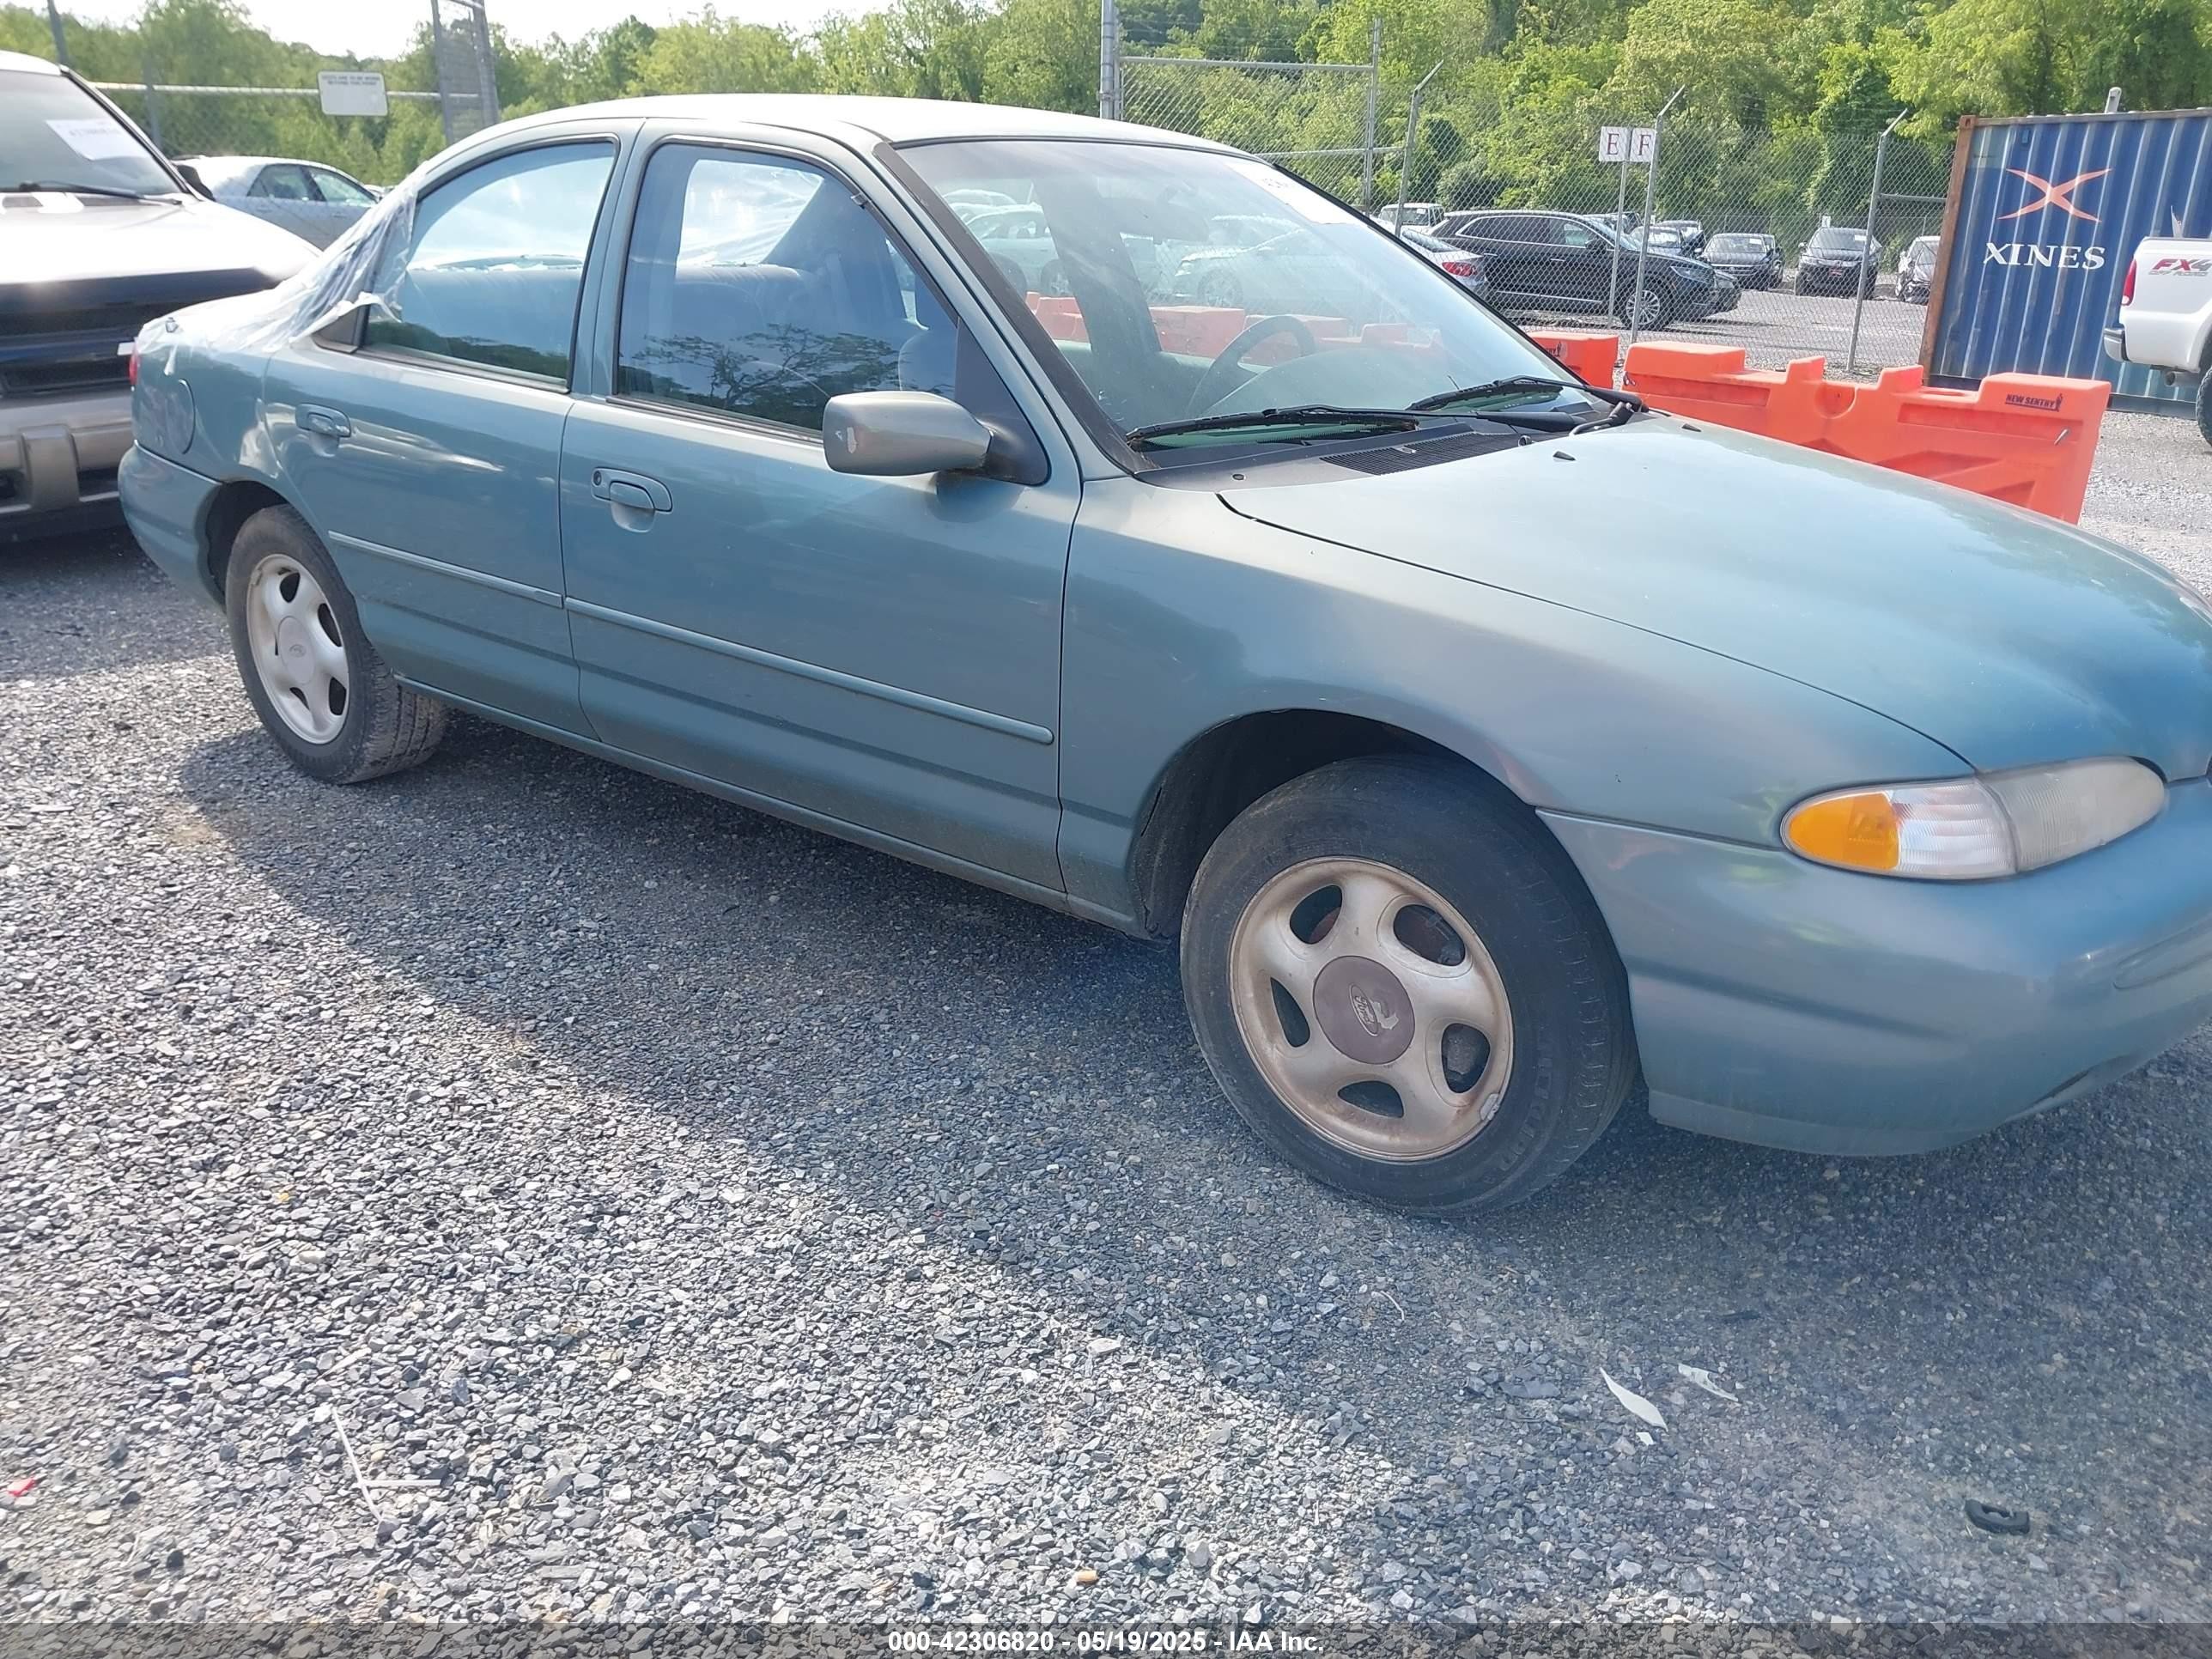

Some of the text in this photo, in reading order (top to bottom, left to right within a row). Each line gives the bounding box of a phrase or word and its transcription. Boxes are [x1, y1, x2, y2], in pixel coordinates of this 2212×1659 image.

[1607, 133, 1620, 155] E
[1636, 134, 1652, 155] F
[1983, 242, 2106, 270] XINES
[2152, 258, 2212, 271] FX4
[2006, 393, 2056, 408] NEW SENTRY
[1353, 995, 1376, 1024] Ford
